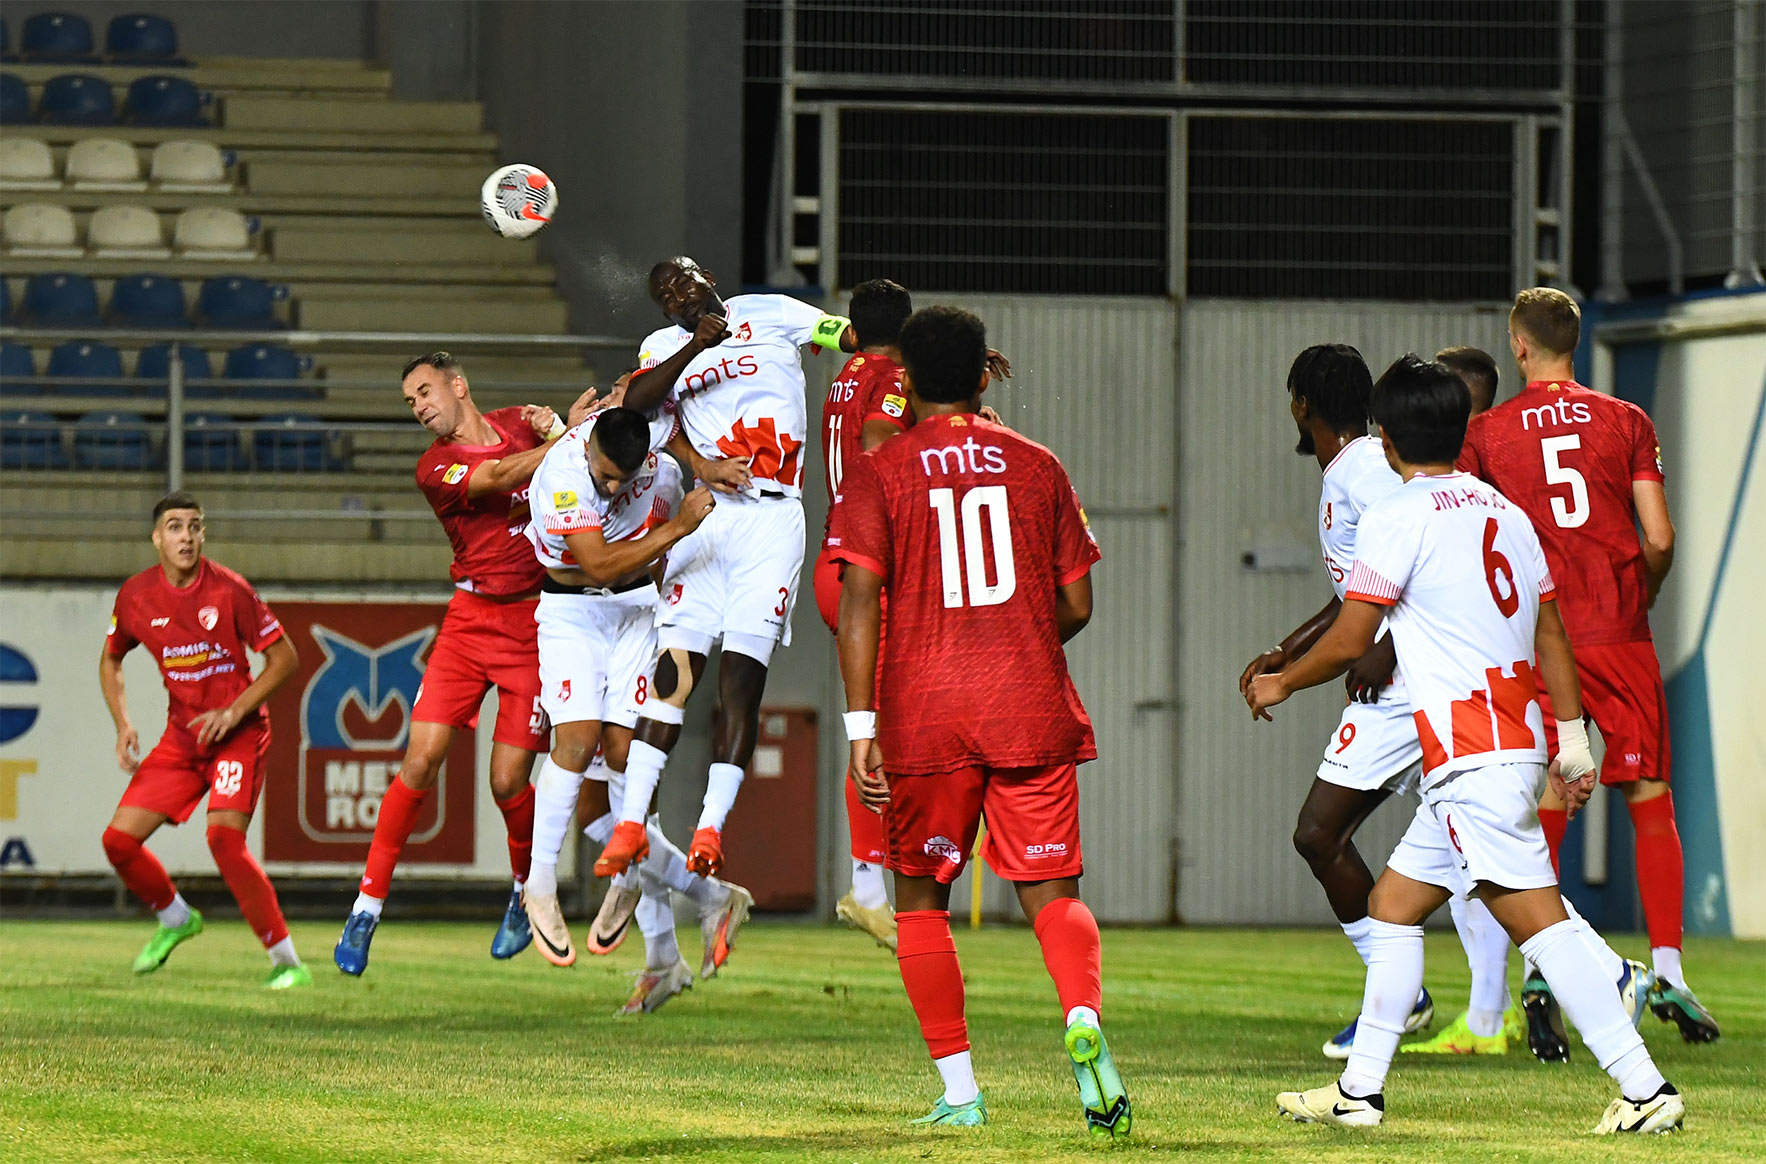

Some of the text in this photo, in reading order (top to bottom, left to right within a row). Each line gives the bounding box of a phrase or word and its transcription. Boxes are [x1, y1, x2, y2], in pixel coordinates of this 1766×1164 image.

[684, 355, 759, 399] mts
[1521, 397, 1592, 431] mts
[828, 414, 843, 498] 11
[919, 436, 1007, 477] mts
[1541, 433, 1590, 528] 5
[929, 485, 1017, 609] 10
[1482, 516, 1520, 619] 6
[774, 586, 789, 617] 3
[634, 675, 648, 706] 8
[1335, 722, 1356, 755] 9
[214, 760, 243, 793] 32
[325, 796, 382, 829] RO
